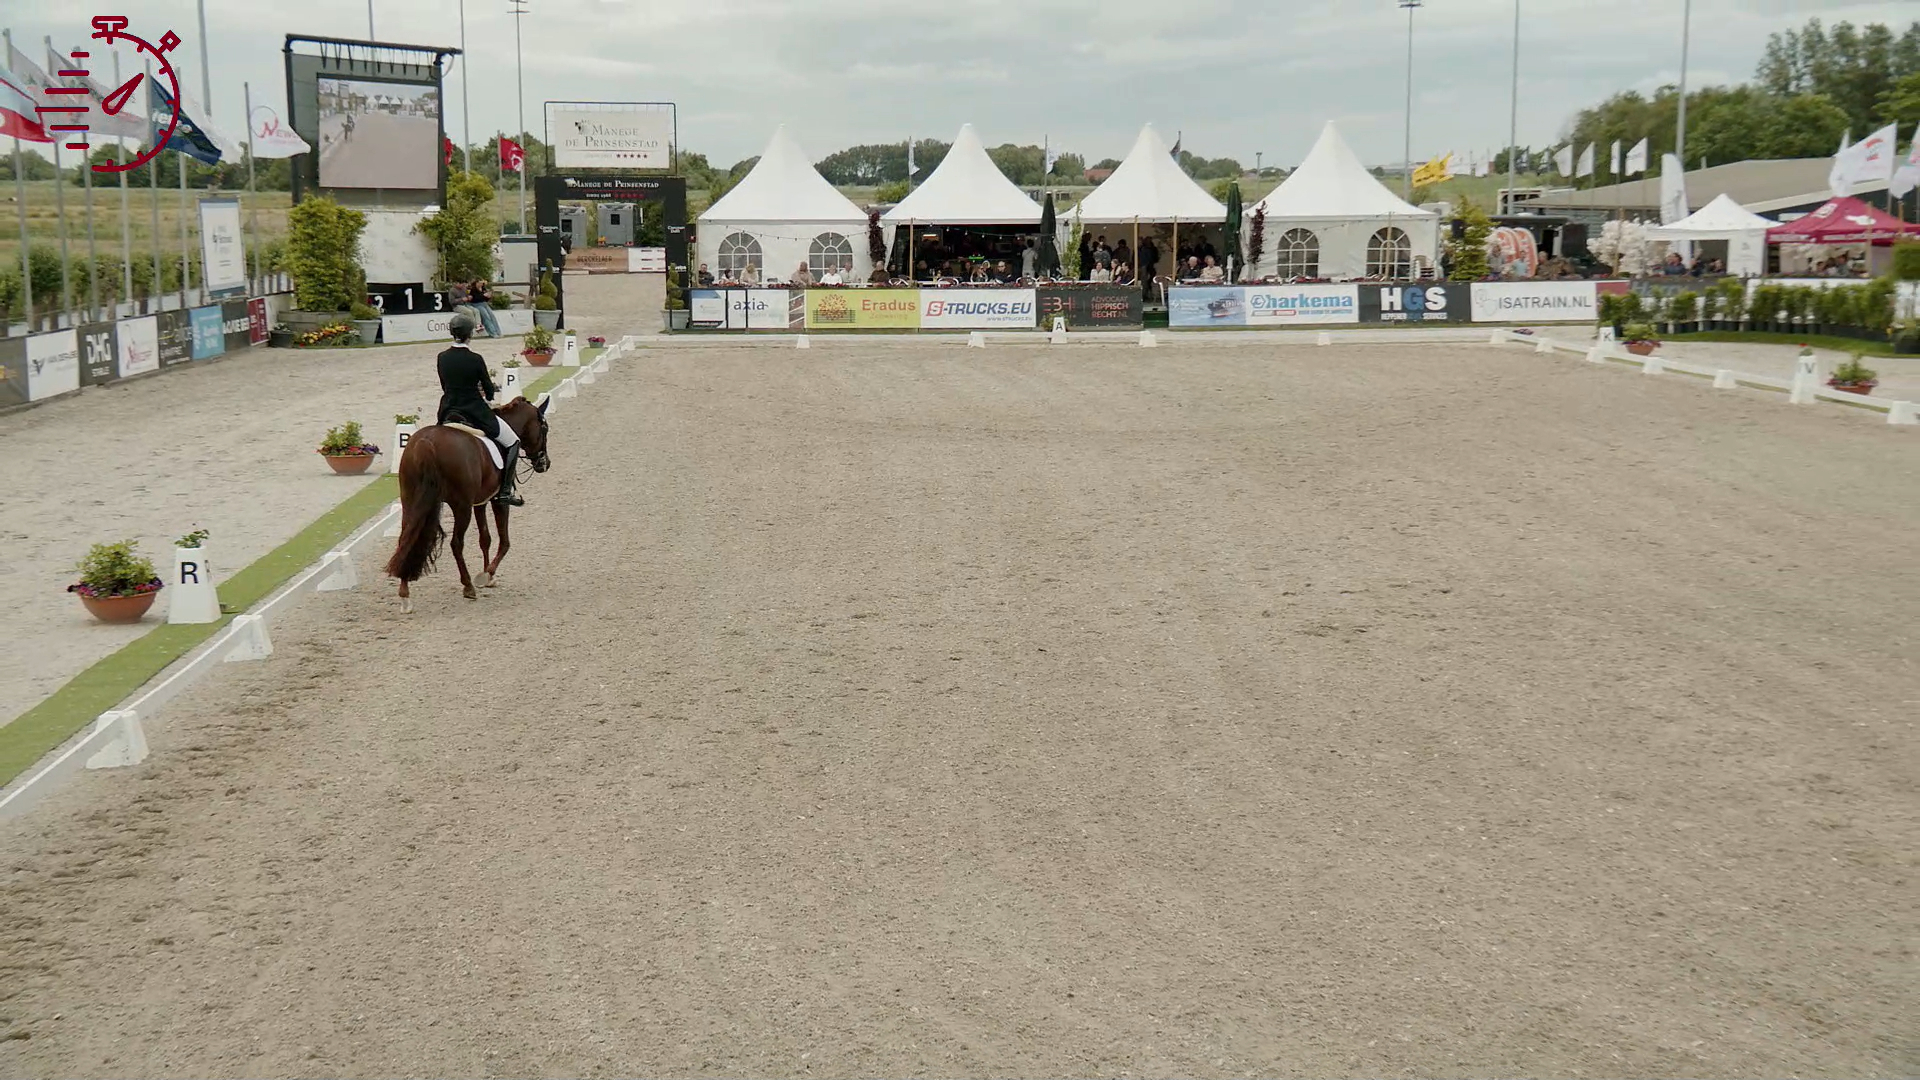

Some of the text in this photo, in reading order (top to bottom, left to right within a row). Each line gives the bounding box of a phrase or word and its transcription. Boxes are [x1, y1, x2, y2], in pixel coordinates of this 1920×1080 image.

[374, 295, 384, 313] 2
[404, 288, 413, 310] 1
[434, 293, 443, 311] 3
[733, 298, 769, 311] axia
[862, 299, 916, 311] Eradus
[1380, 286, 1447, 311] HGS
[1499, 297, 1592, 309] ISATRAIN.NL
[1056, 322, 1063, 331] A
[1603, 331, 1612, 342] K
[567, 341, 574, 351] F
[1804, 362, 1816, 374] V
[507, 374, 515, 387] P
[399, 433, 410, 448] B
[181, 561, 199, 585] R
